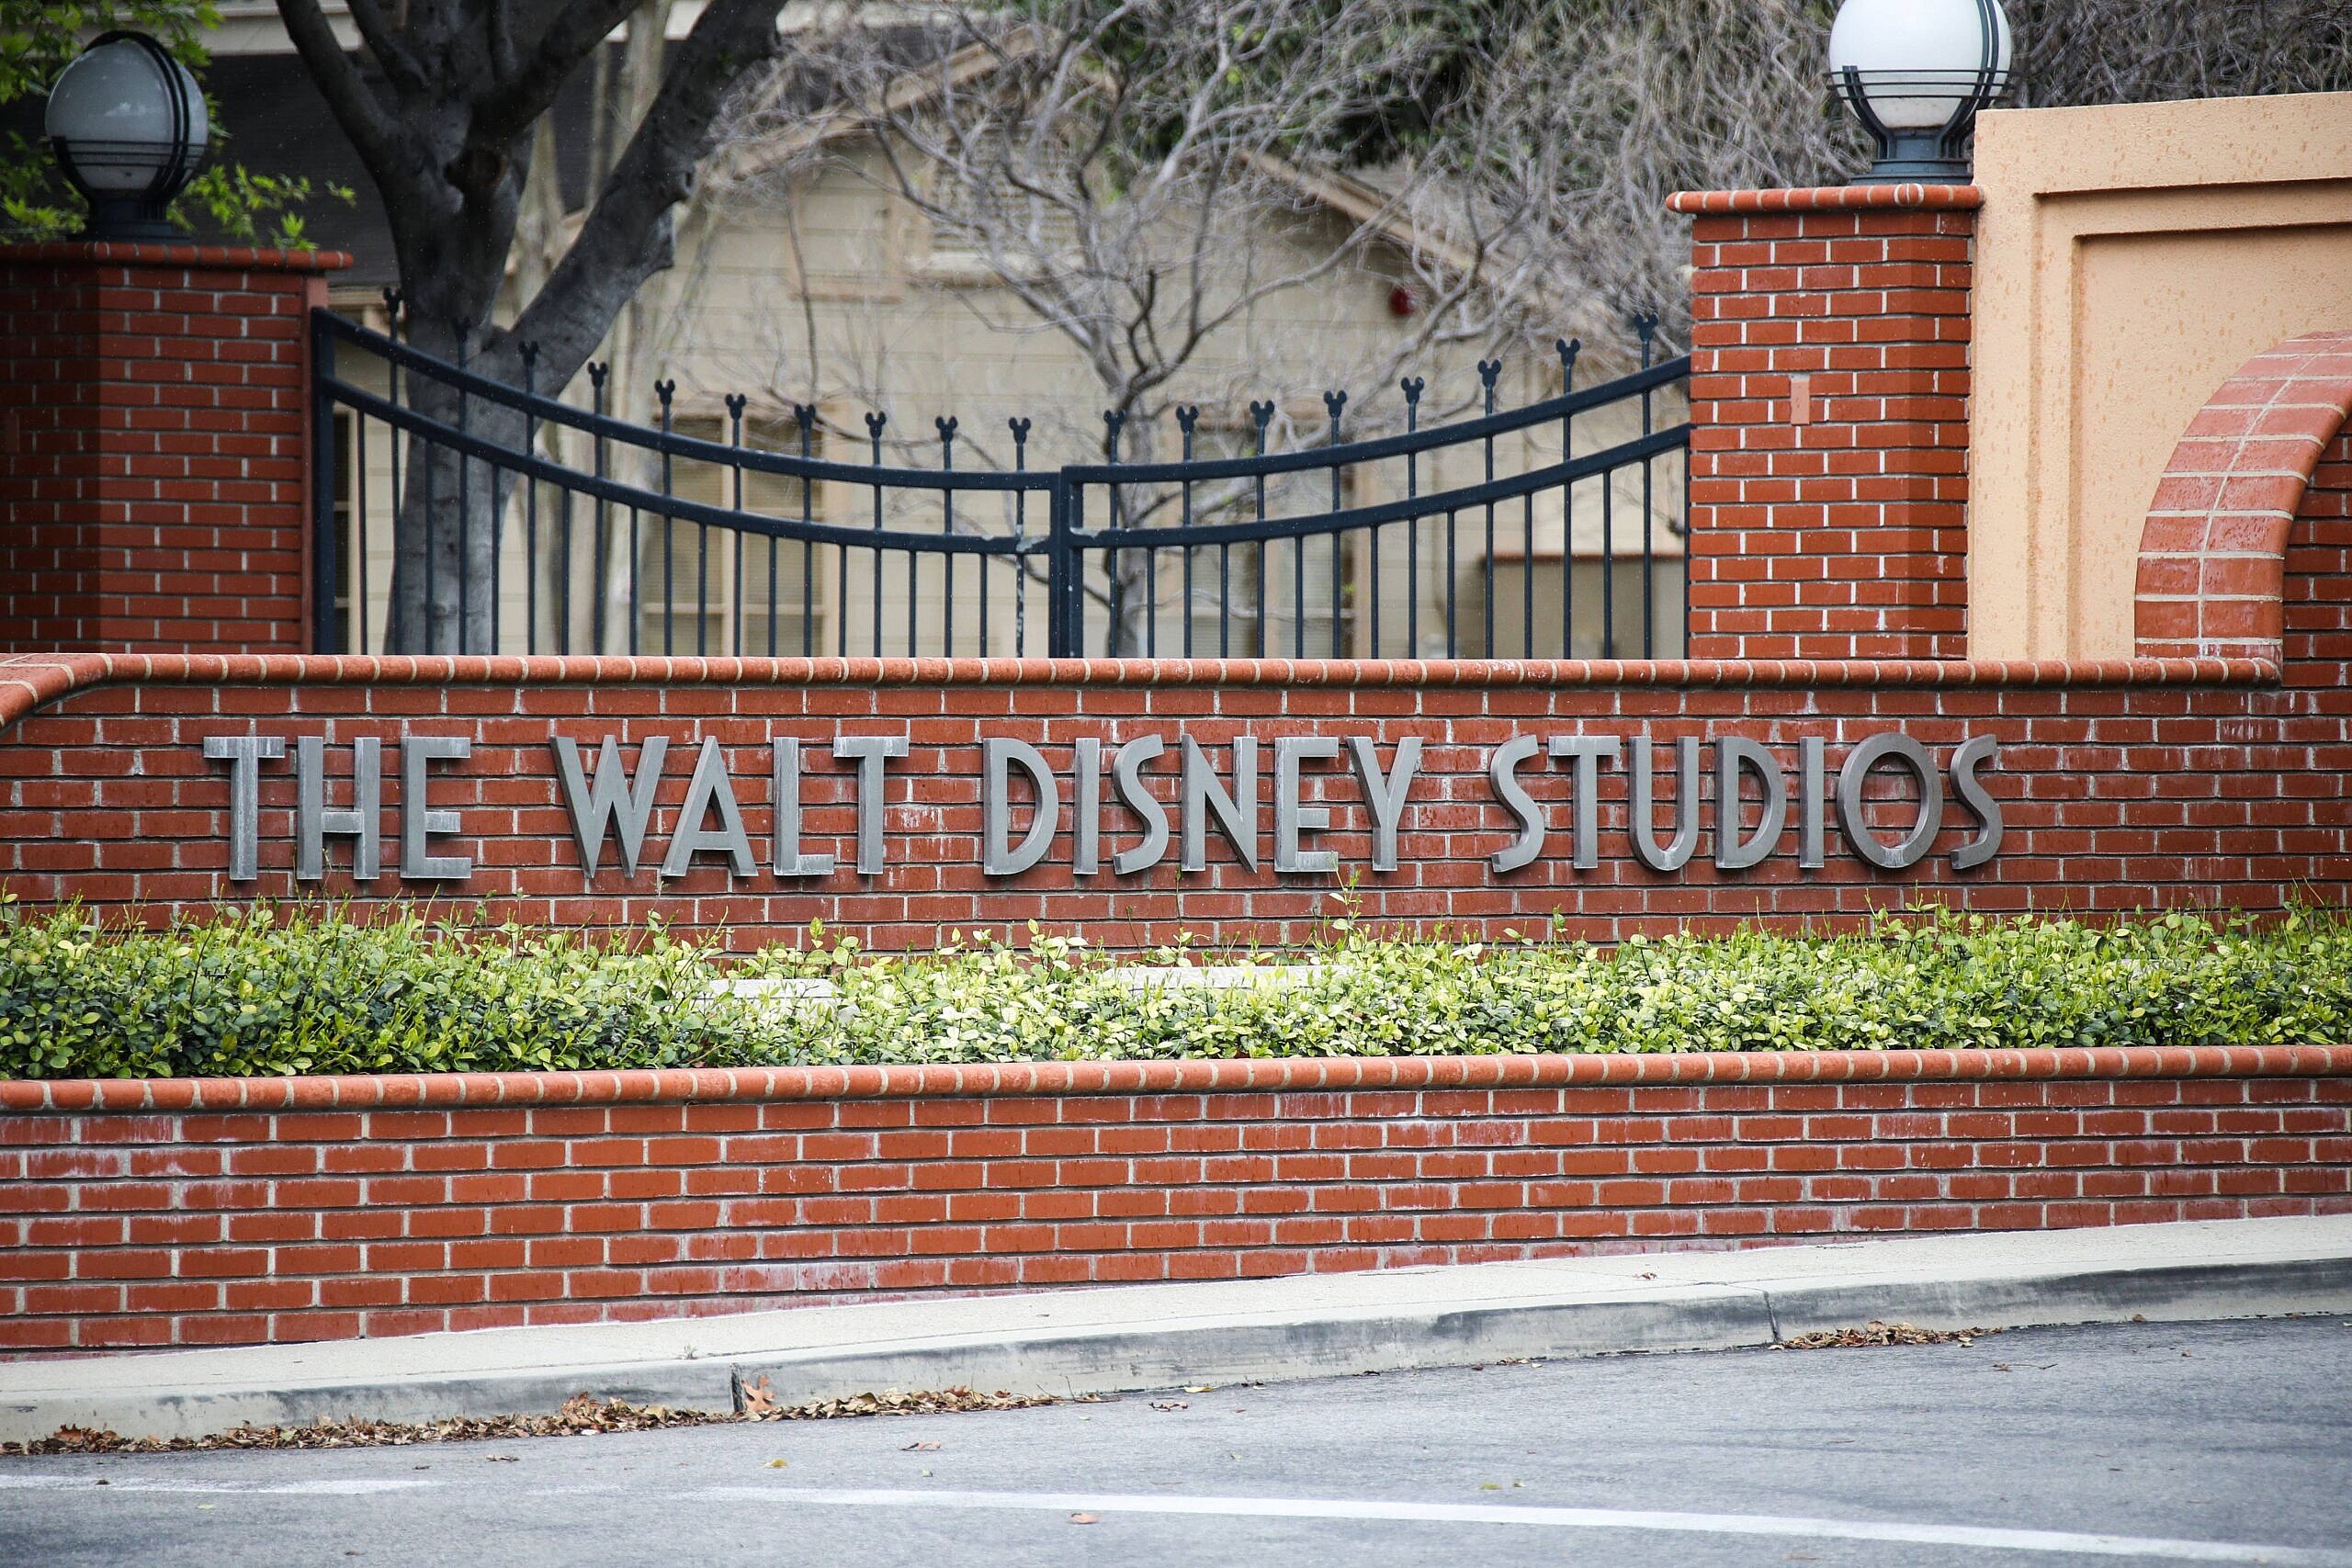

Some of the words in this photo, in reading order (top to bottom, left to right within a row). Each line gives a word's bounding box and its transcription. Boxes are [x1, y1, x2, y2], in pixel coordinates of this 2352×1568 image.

[203, 736, 471, 881] THE
[552, 735, 910, 879] WALT
[983, 734, 1424, 875] DISNEY
[1489, 733, 2004, 873] STUDIOS
